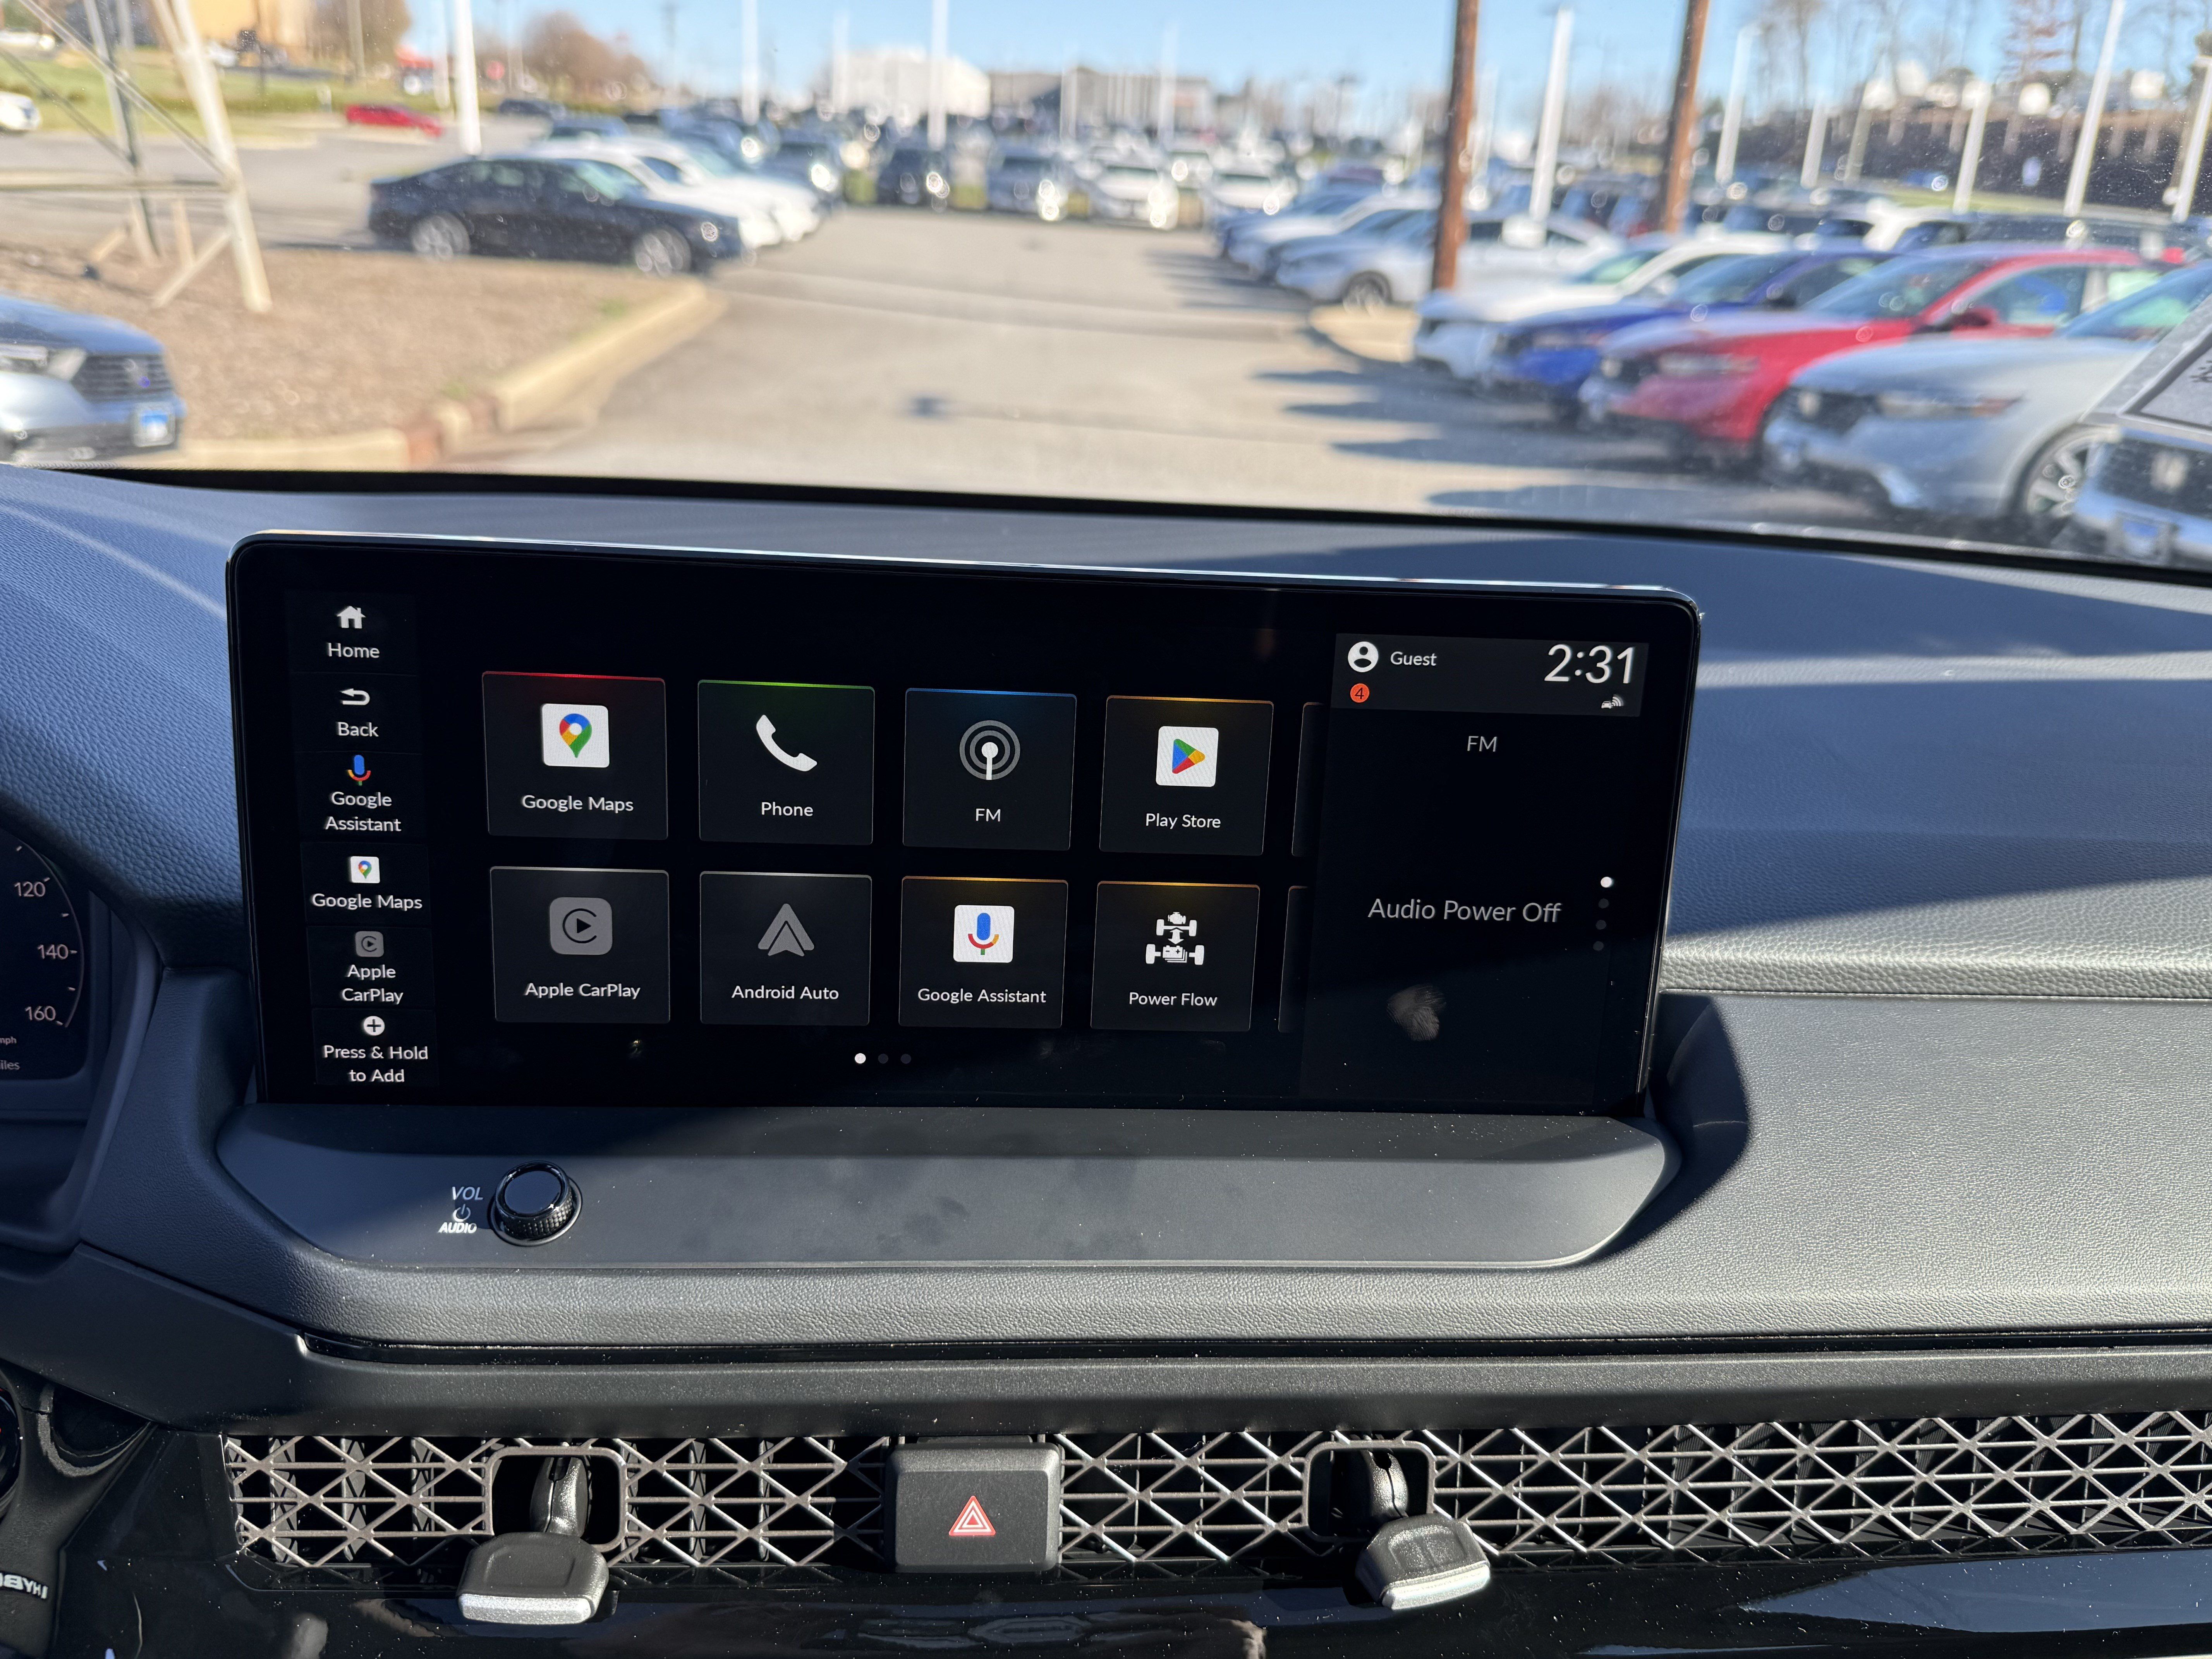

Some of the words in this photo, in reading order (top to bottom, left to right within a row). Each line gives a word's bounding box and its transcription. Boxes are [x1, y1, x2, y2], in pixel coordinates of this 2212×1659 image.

[328, 643, 380, 658] Home
[1391, 652, 1437, 666] Guest
[1545, 644, 1633, 684] 2:31
[1354, 687, 1364, 699] 4
[338, 722, 378, 737] Back
[1467, 736, 1497, 752] FM
[331, 792, 392, 809] Google
[522, 795, 582, 812] Google
[589, 797, 633, 813] Maps
[762, 802, 813, 816] Phone
[976, 809, 1000, 821] FM
[326, 817, 401, 831] Assistant
[1146, 813, 1176, 829] Play
[1182, 815, 1221, 828] Store
[15, 881, 46, 898] 120
[312, 893, 371, 910] Google
[378, 895, 422, 911] Maps
[1368, 899, 1435, 919] Audio
[1444, 900, 1516, 921] Power
[1523, 903, 1561, 922] Off
[38, 944, 68, 959] 140
[347, 965, 395, 980] Apple
[342, 988, 403, 1004] CarPlay
[525, 983, 574, 998] Apple
[579, 984, 640, 999] CarPlay
[732, 986, 794, 998] Android
[800, 987, 838, 999] Auto
[918, 989, 972, 1003] Google
[978, 989, 1046, 1003] Assistant
[1130, 992, 1176, 1005] Power
[1182, 993, 1217, 1006] Flow
[25, 1006, 56, 1021] 160
[324, 1045, 366, 1058] Press
[371, 1046, 384, 1058] &
[390, 1046, 428, 1059] Hold
[0, 1060, 20, 1070] iles
[349, 1070, 366, 1081] to
[371, 1069, 404, 1082] Add
[452, 1187, 483, 1200] VOL
[438, 1222, 477, 1233] AUDIO
